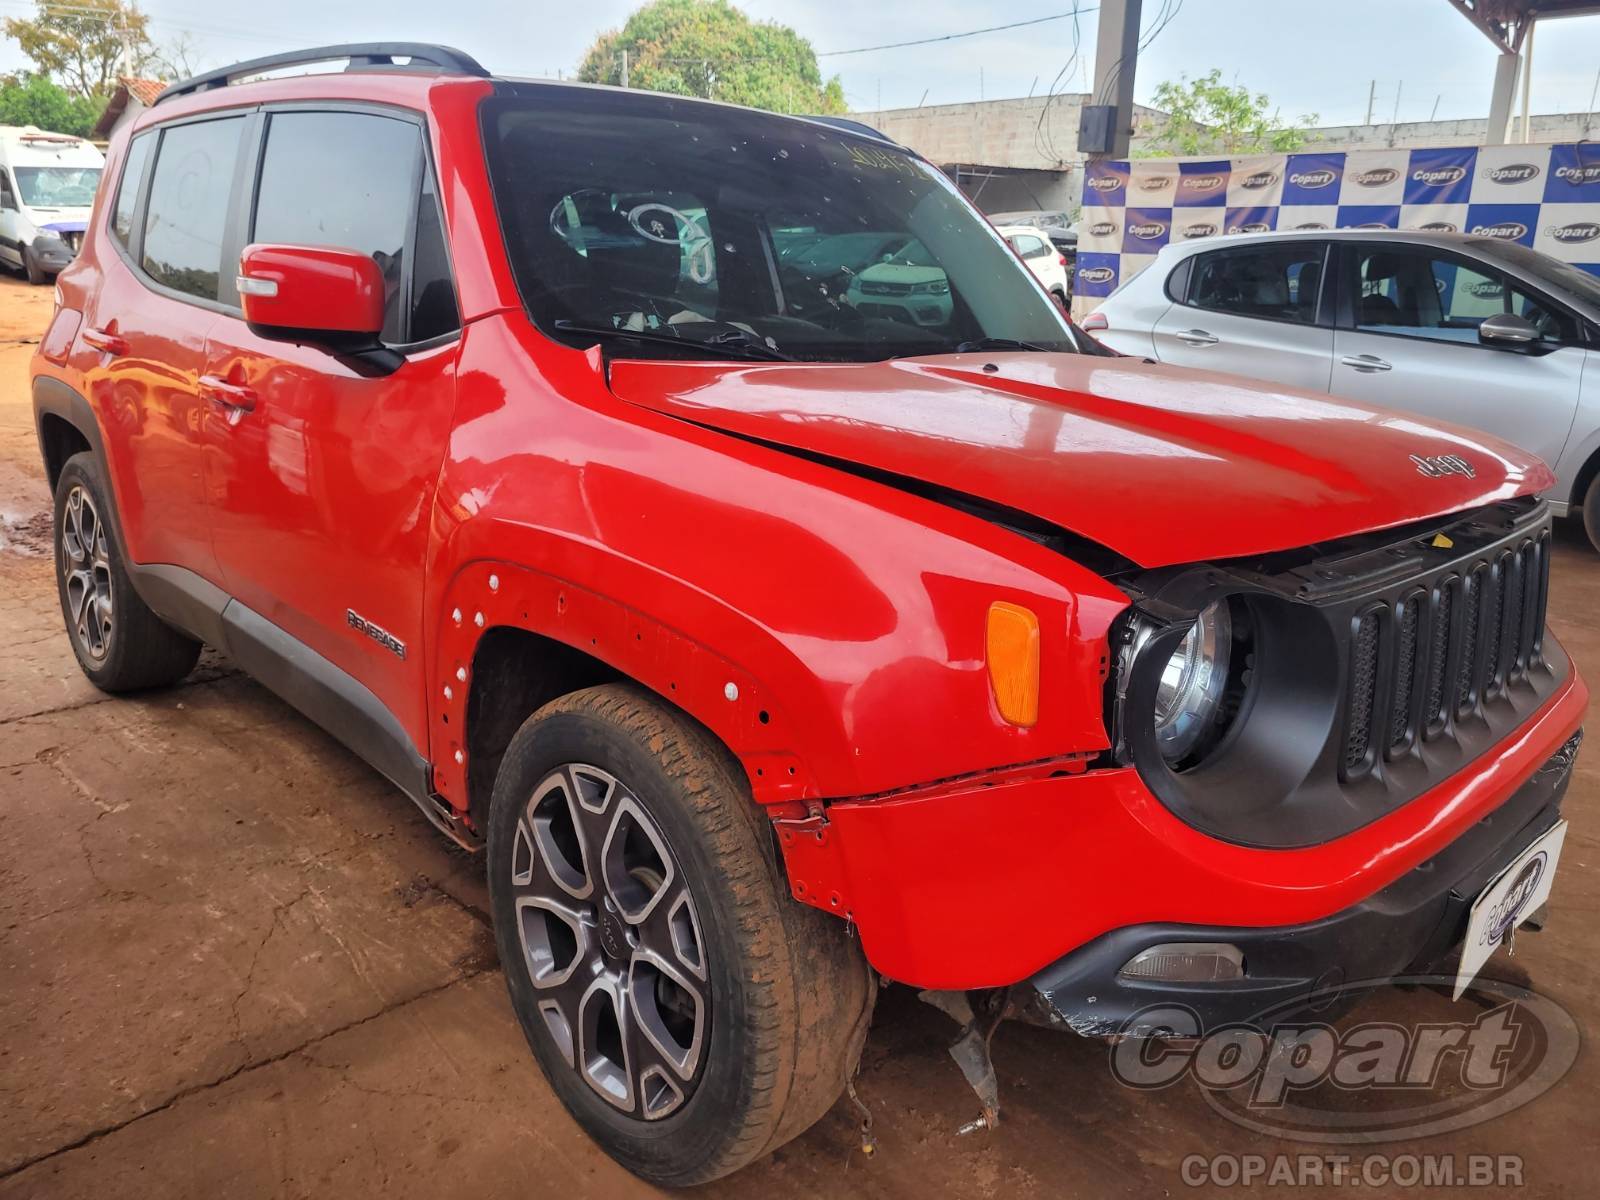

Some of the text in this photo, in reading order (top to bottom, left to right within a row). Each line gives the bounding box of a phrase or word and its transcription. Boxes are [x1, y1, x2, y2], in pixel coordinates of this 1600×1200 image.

[1289, 172, 1330, 185] Copart
[1412, 168, 1460, 182] Copart
[1182, 177, 1219, 190] Copart
[1128, 225, 1163, 237] Copart
[1471, 225, 1521, 238] Copart
[1408, 454, 1476, 480] Jeep
[346, 608, 407, 660] RENEGADE
